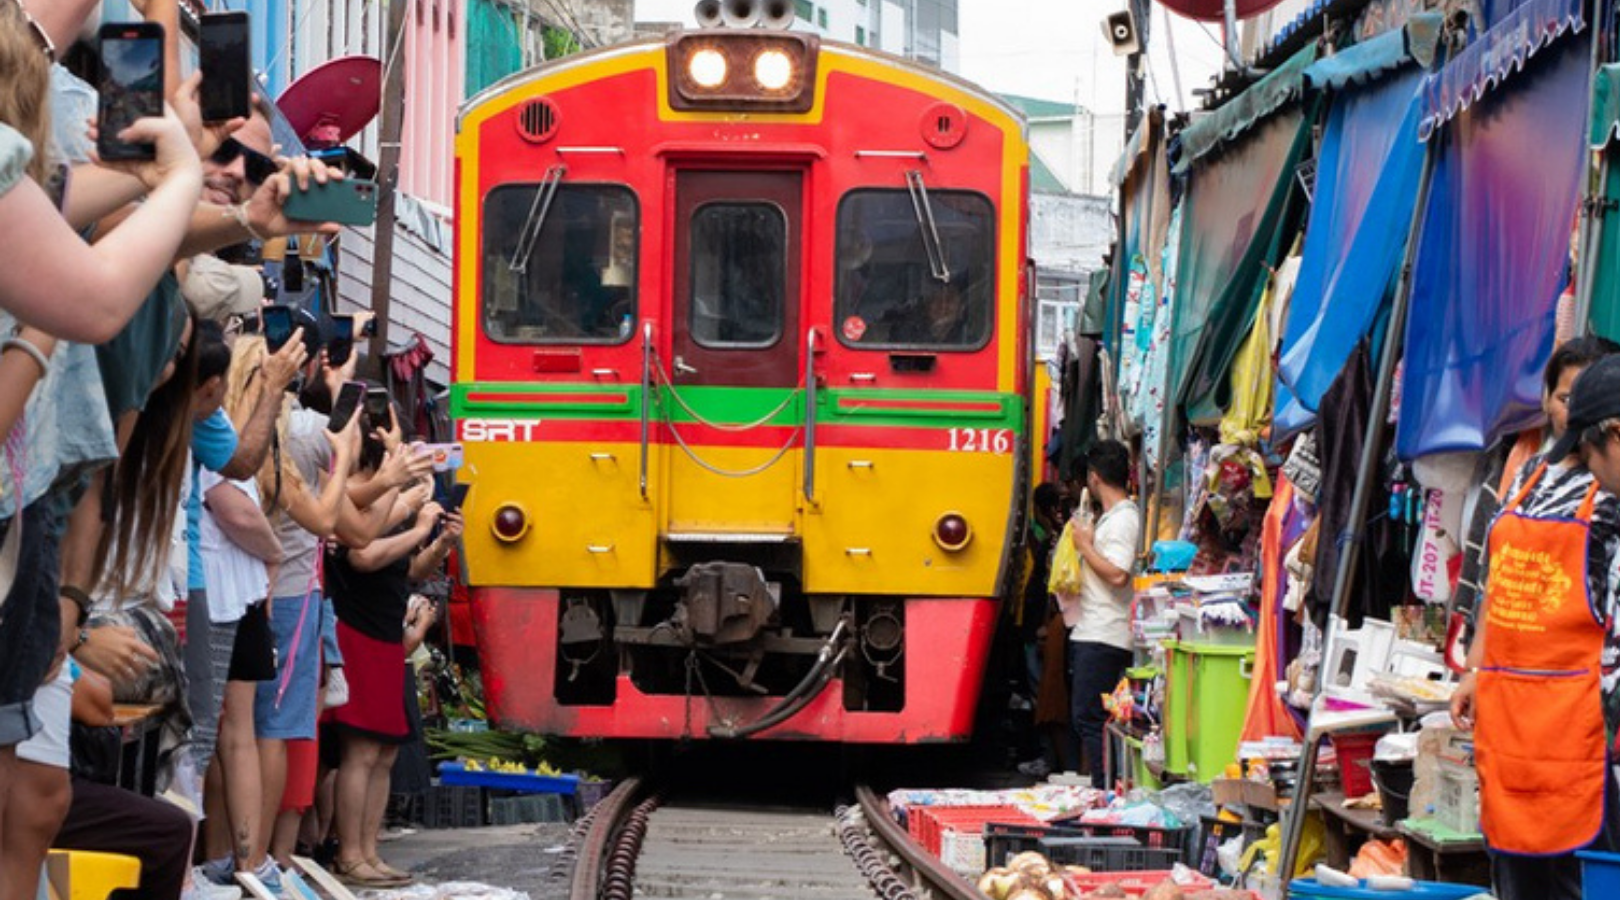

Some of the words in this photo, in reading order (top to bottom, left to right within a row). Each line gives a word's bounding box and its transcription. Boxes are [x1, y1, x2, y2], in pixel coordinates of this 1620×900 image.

[462, 418, 541, 442] SRT
[948, 428, 1008, 456] 1216
[1417, 542, 1439, 598] JT-207
